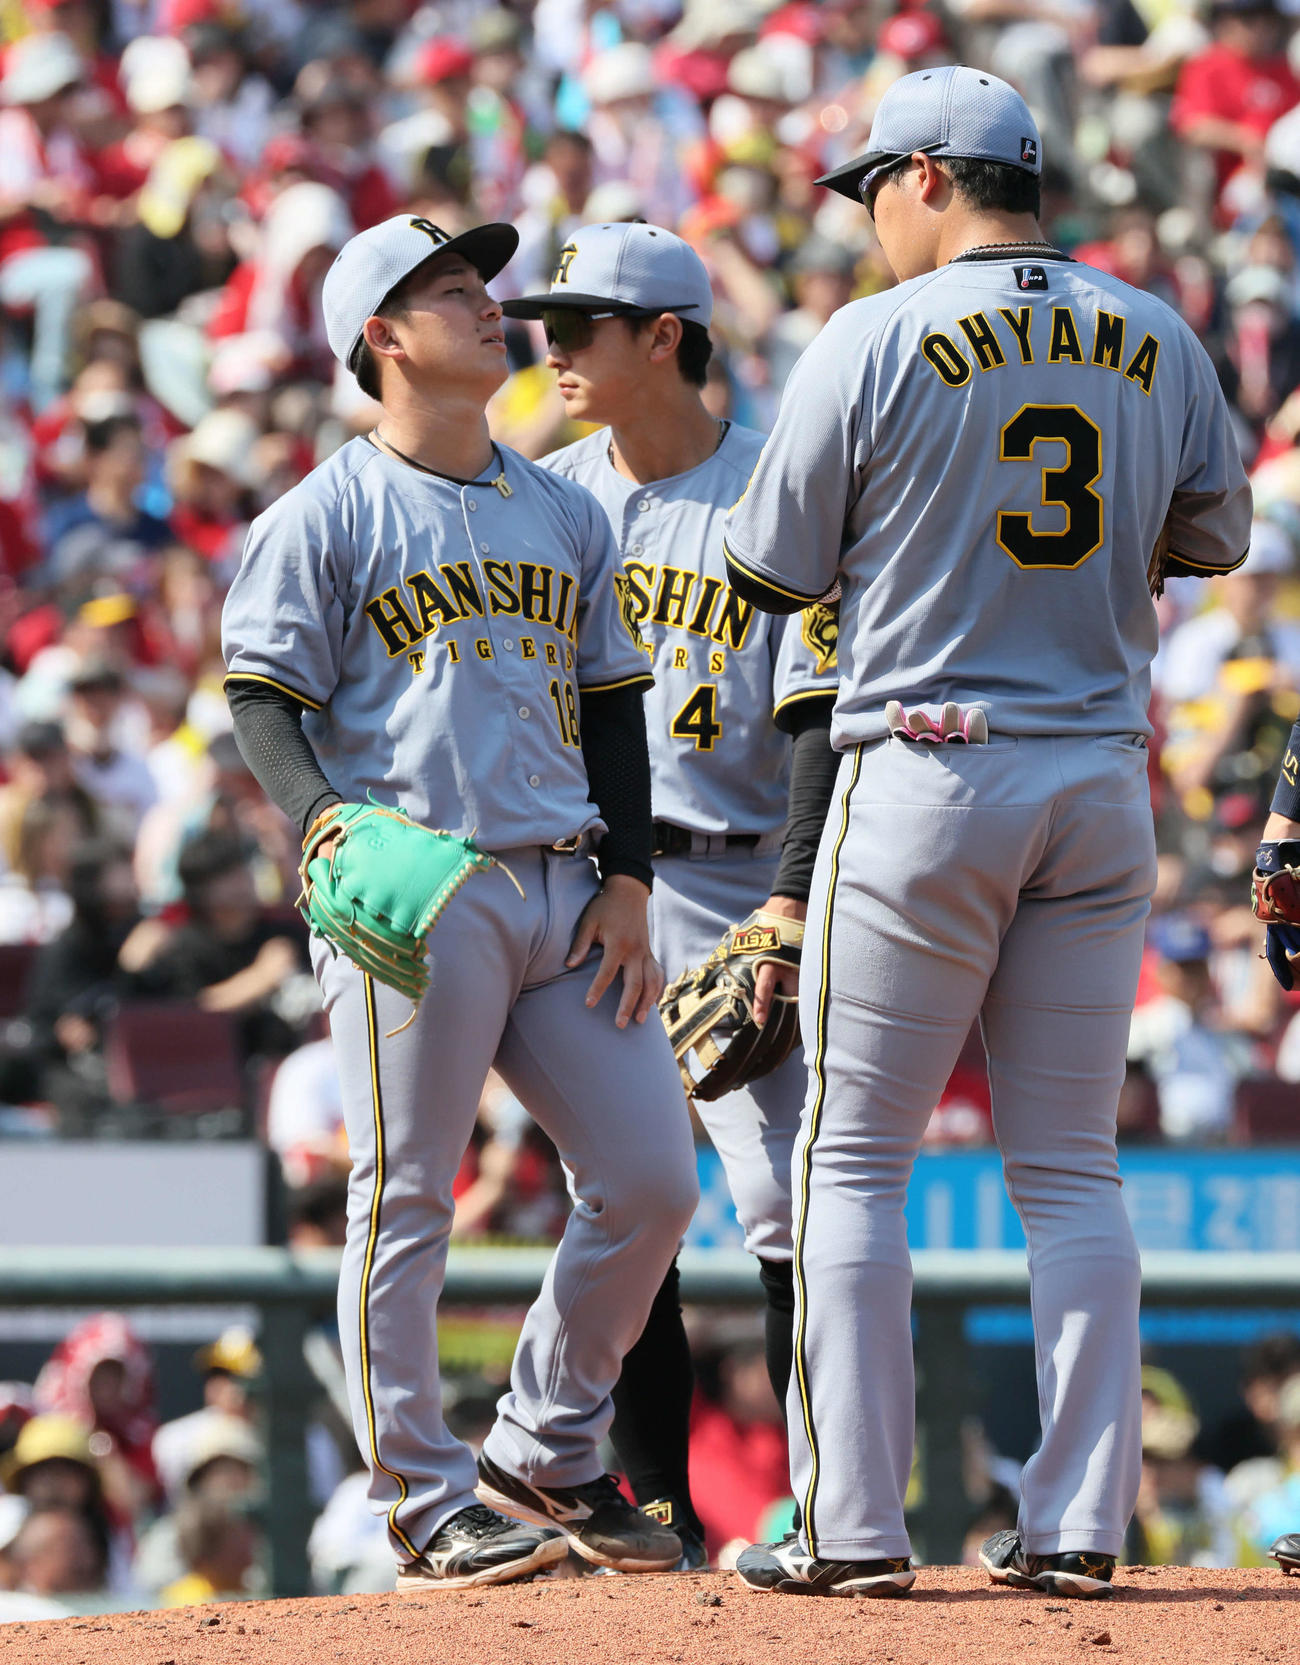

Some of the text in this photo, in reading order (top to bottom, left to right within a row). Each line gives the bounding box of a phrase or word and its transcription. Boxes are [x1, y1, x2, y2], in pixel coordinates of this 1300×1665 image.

[921, 305, 1160, 397] OHYAMA
[996, 403, 1104, 570] 3
[408, 636, 574, 675] TIGERS
[549, 678, 581, 749] 18
[670, 682, 722, 752] 4
